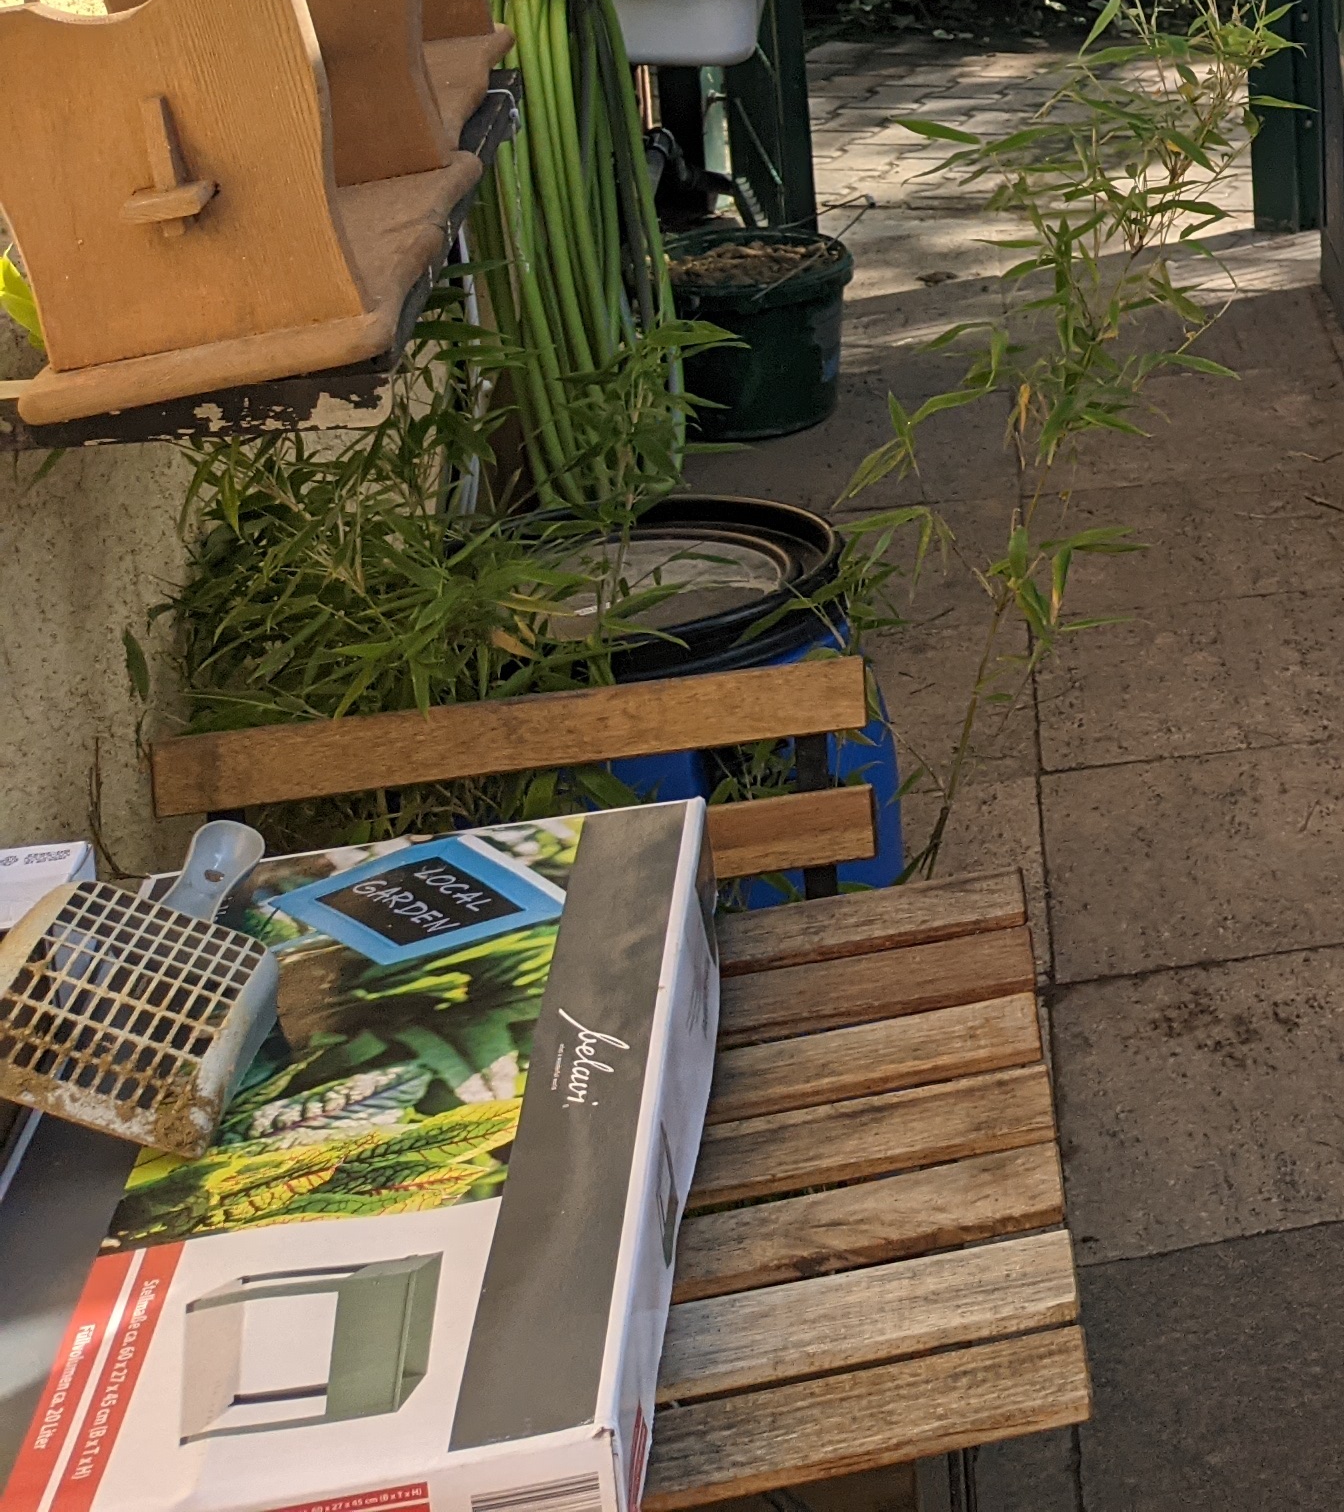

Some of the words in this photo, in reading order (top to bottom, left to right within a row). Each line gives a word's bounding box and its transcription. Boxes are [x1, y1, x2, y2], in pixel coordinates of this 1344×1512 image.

[413, 864, 492, 912] LOCAL
[352, 880, 461, 933] GARDEN
[558, 1008, 630, 1106] belavi
[128, 1279, 160, 1329] Stellmaße
[122, 1330, 138, 1346] ca.
[56, 1323, 96, 1391] Füllvolumen
[117, 1347, 135, 1361] 60
[113, 1360, 128, 1370] x
[109, 1369, 128, 1382] 27
[105, 1384, 120, 1393] x
[50, 1391, 67, 1408] ca.
[100, 1393, 119, 1407] 45
[44, 1407, 64, 1423] 20
[93, 1408, 110, 1426] cm
[33, 1422, 59, 1449] Liter
[88, 1426, 108, 1439] (B
[82, 1446, 100, 1456] T
[84, 1439, 100, 1449] x
[78, 1456, 93, 1467] x
[71, 1464, 94, 1480] H)
[331, 1502, 343, 1511] 27
